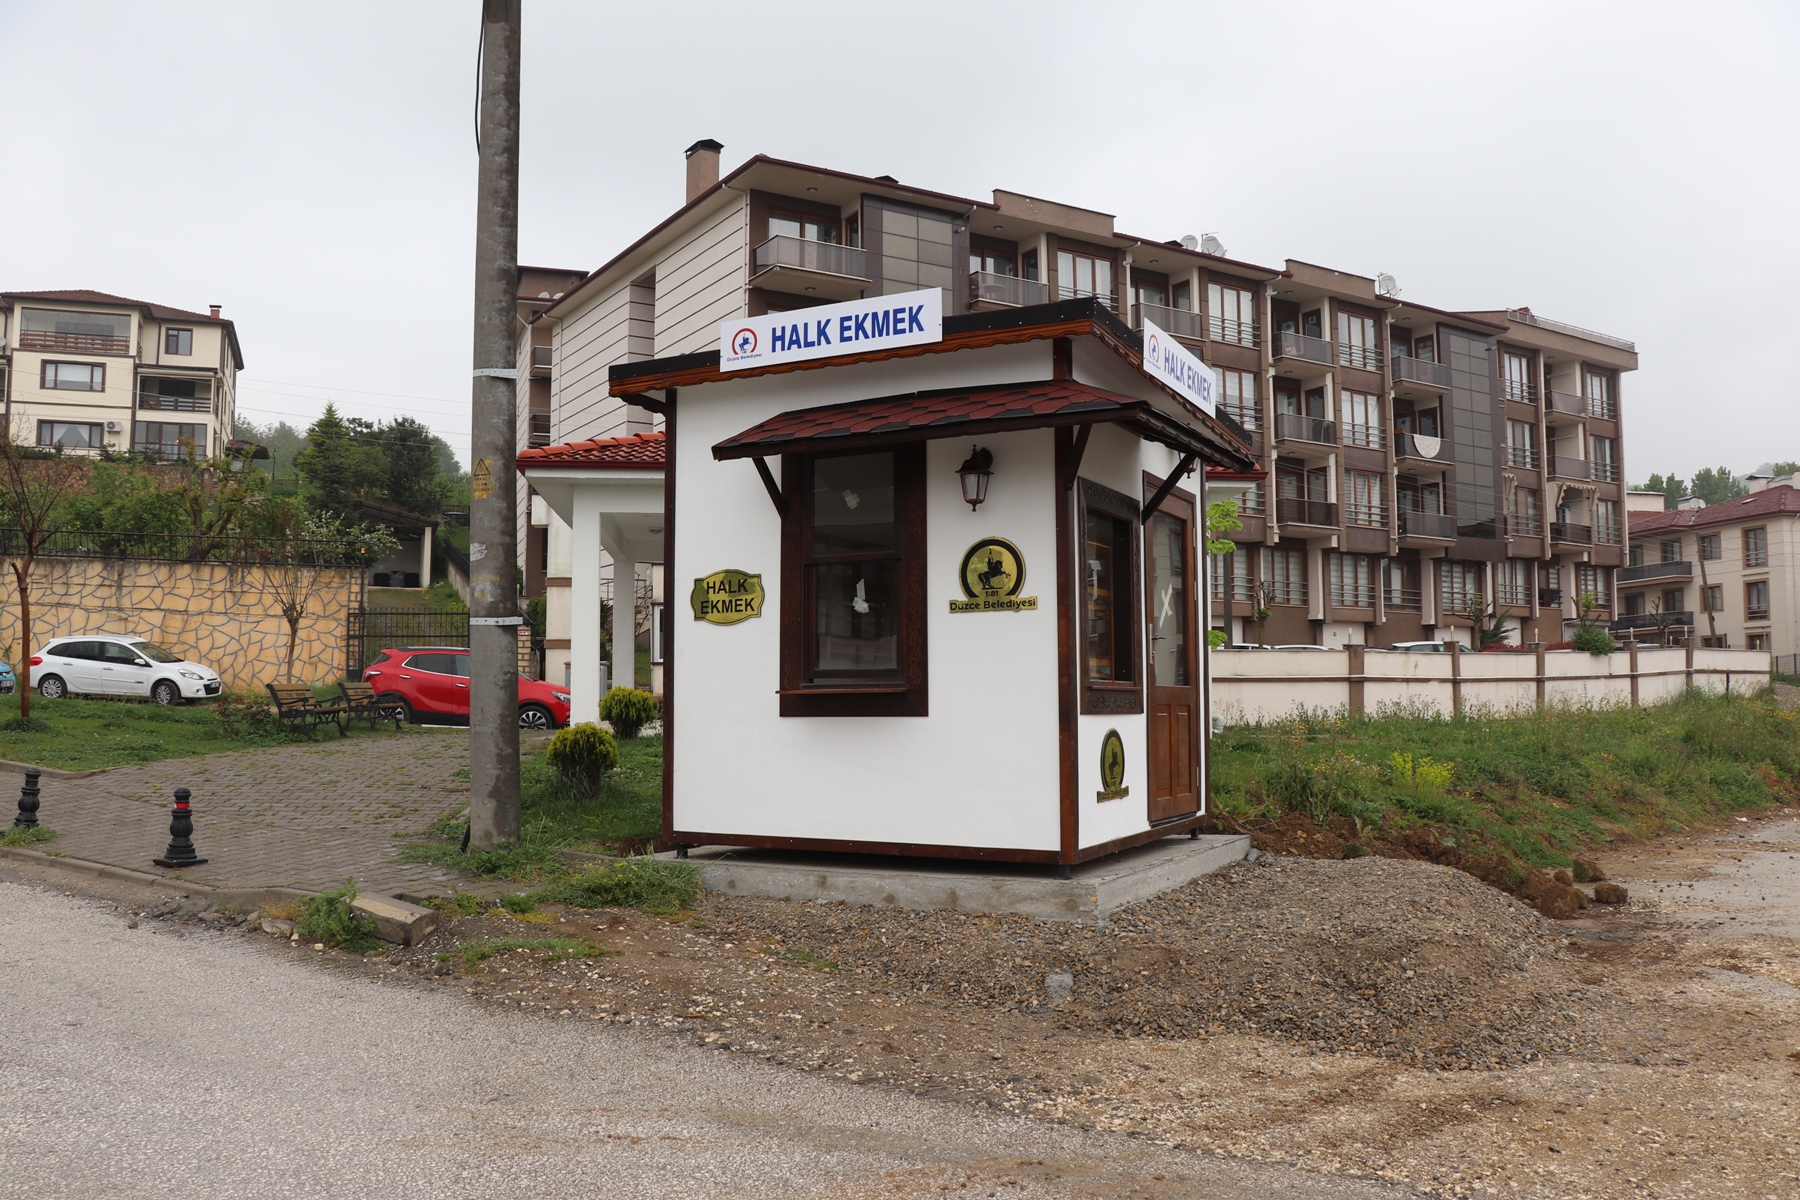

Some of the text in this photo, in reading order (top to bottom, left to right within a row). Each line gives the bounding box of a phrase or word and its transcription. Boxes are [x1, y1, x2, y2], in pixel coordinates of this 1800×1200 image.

[771, 304, 925, 353] HALK EKMEK
[1164, 346, 1212, 406] HALK EKMEK
[706, 578, 748, 595] HALK
[700, 597, 755, 615] EKMEK
[949, 598, 1036, 611] Düzce Belediyesi
